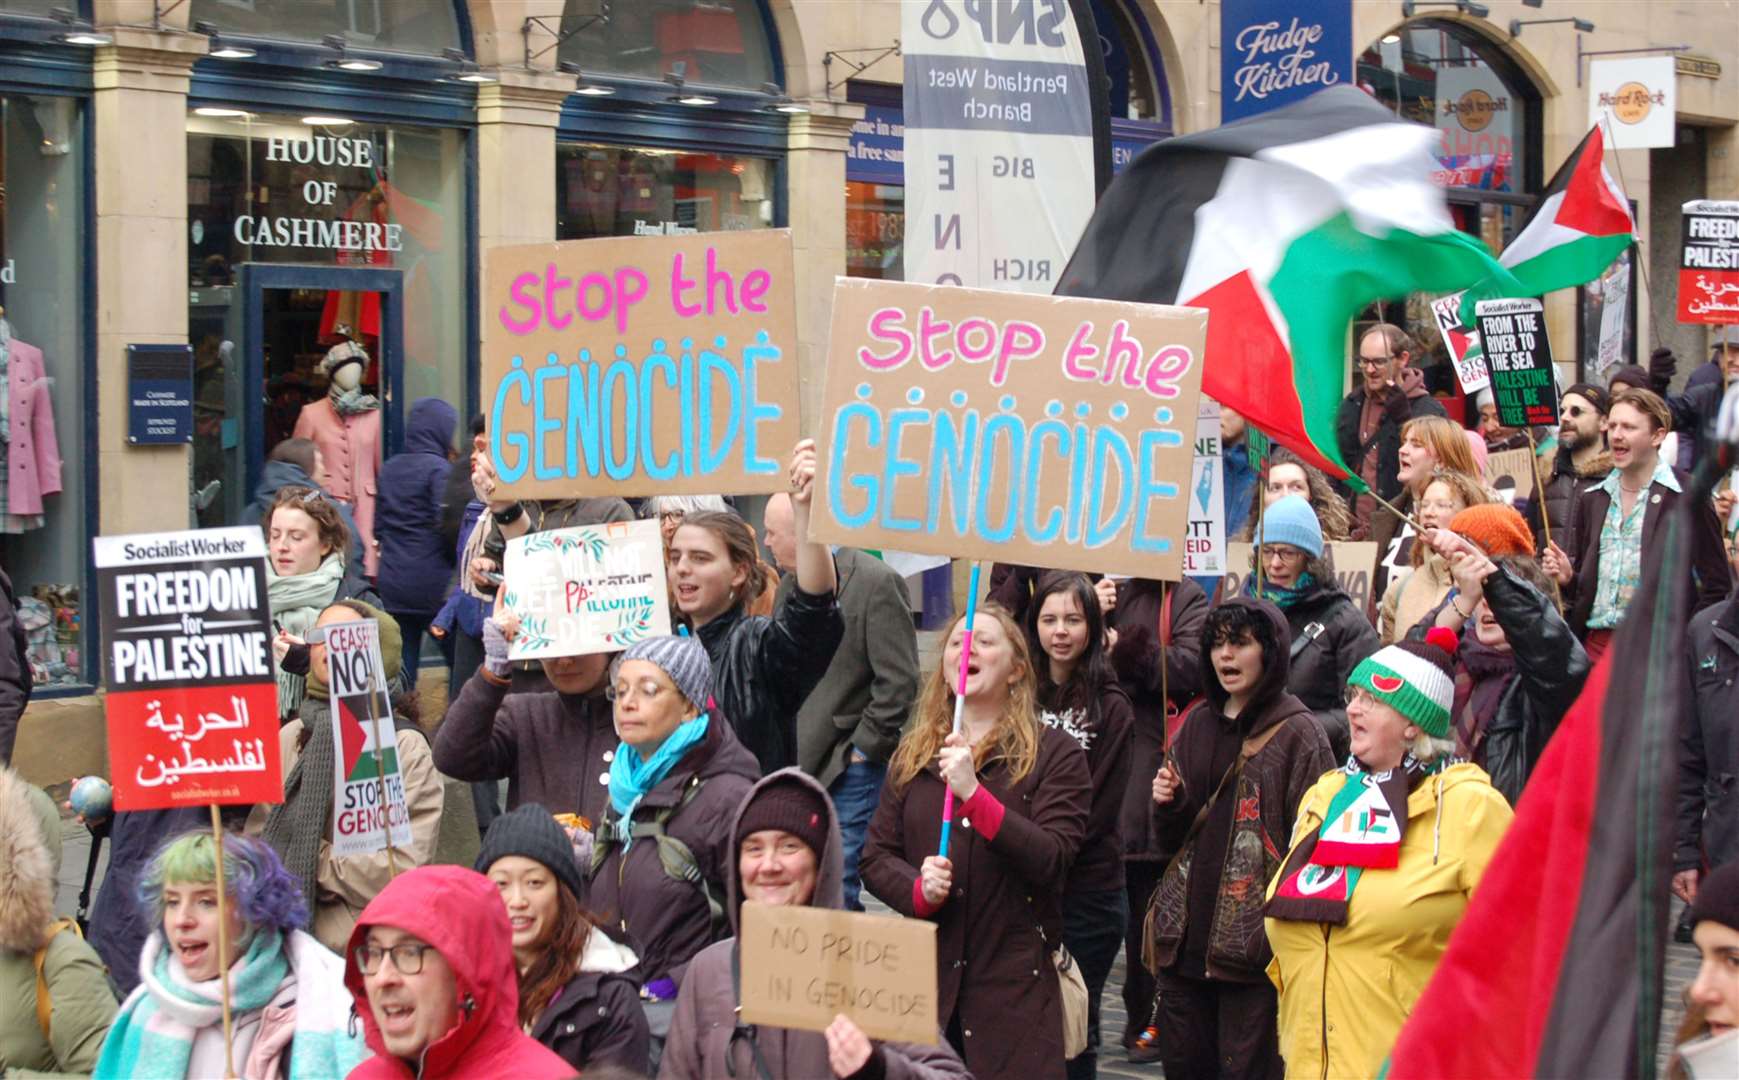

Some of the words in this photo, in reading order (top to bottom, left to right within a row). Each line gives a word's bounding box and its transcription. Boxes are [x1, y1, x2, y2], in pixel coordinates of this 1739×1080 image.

[1235, 17, 1323, 64] Fudge
[1234, 58, 1339, 102] Kitchen
[1598, 90, 1631, 107] Hard
[1633, 89, 1665, 108] Rock
[265, 136, 373, 168] HOUSE
[858, 141, 883, 161] free
[303, 180, 337, 205] OF
[234, 215, 403, 251] CASHMERE
[671, 247, 772, 317] the
[1483, 316, 1514, 335] FROM
[1515, 314, 1538, 332] THE
[858, 305, 1046, 387] Stop
[1063, 320, 1193, 398] the
[1486, 335, 1518, 353] RIVER
[1518, 333, 1535, 351] TO
[1489, 353, 1511, 371] THE
[1512, 351, 1535, 369] SEA
[1494, 369, 1550, 388] PALESTINE
[490, 333, 783, 484] GENOCIDE
[1497, 389, 1522, 406] WILL
[1523, 388, 1540, 406] BE
[1501, 407, 1526, 425] FREE
[827, 384, 1184, 554] GENOCIDE
[124, 540, 190, 560] Socialist
[191, 537, 247, 556] Worker
[115, 566, 258, 618] FREEDOM
[181, 613, 203, 635] for
[113, 631, 269, 684] PALESTINE
[145, 695, 250, 741] الحرية
[136, 738, 266, 787] لفلسطين
[344, 781, 382, 809] STOP
[771, 926, 809, 955] NO
[820, 932, 900, 972] PRIDE
[767, 975, 792, 1004] IN
[806, 977, 928, 1017] GENOCIDE
